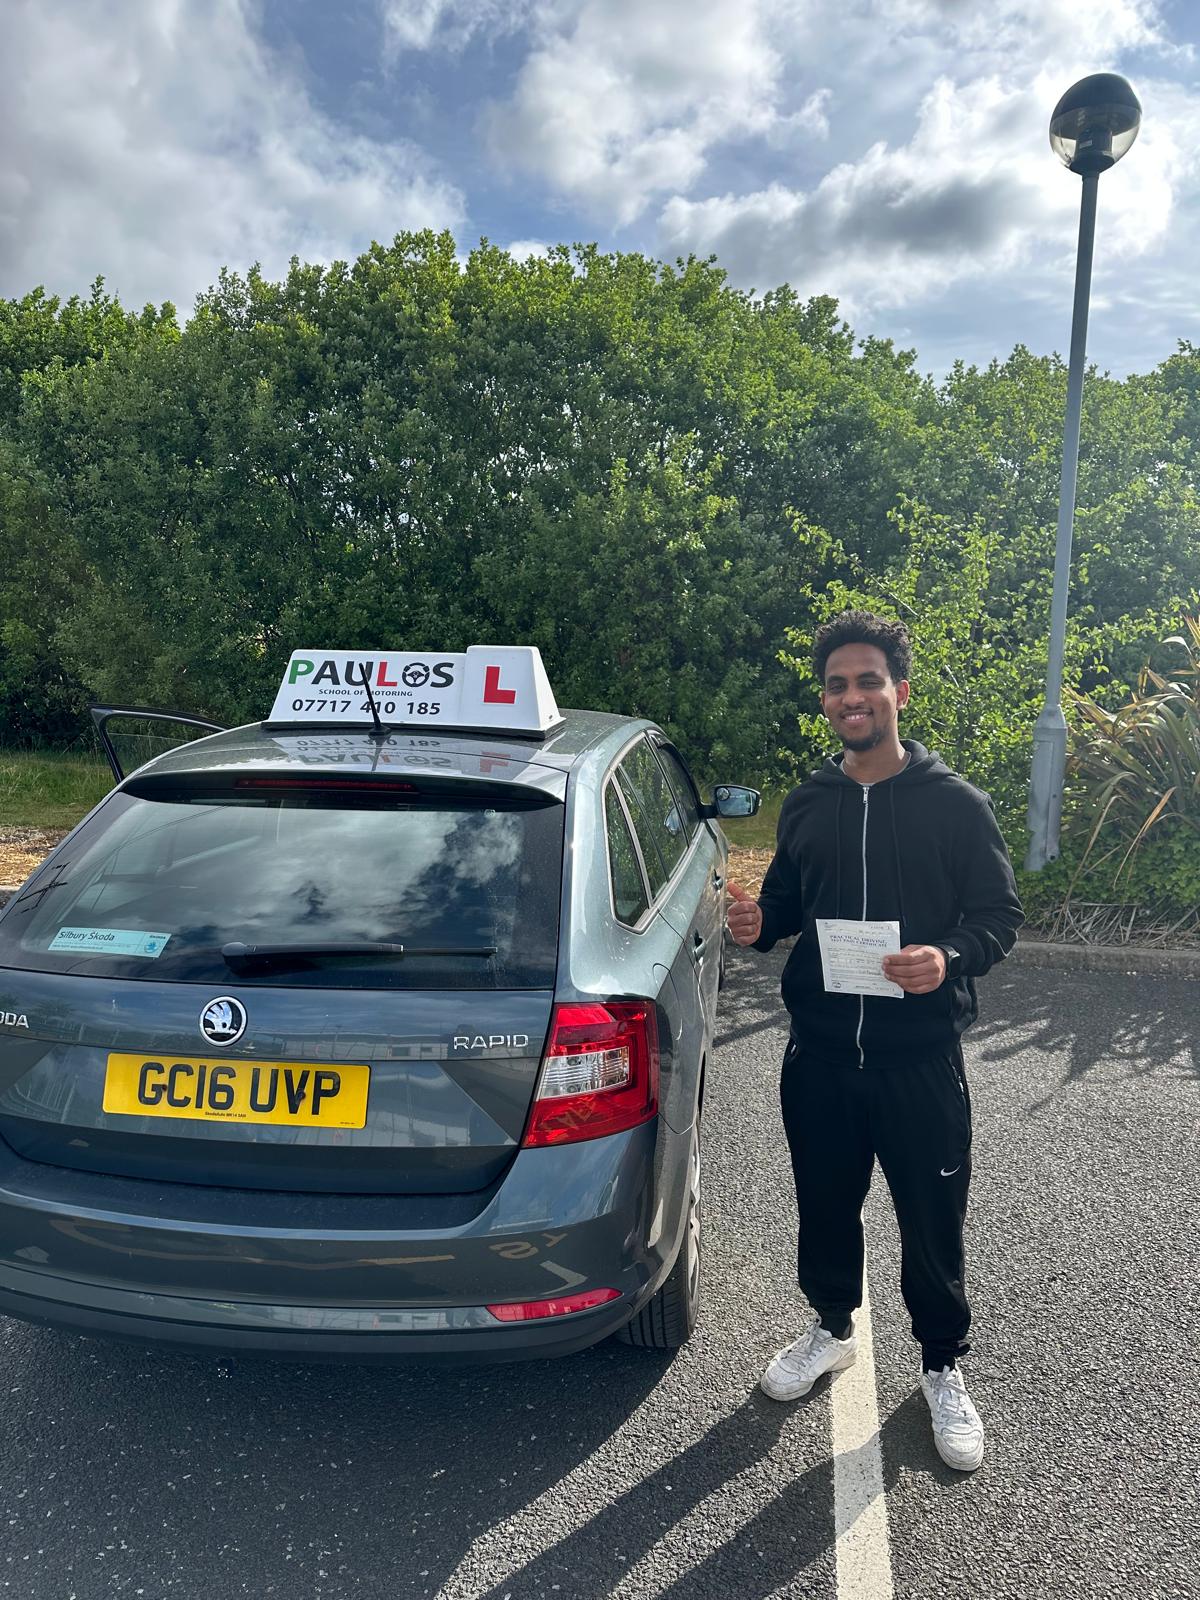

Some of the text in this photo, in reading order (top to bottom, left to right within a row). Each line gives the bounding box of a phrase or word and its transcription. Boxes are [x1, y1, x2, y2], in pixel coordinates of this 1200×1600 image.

[287, 659, 455, 688] PAULOS
[318, 688, 352, 696] SCHOOL
[483, 665, 517, 704] L
[292, 698, 441, 715] 07717 410 185
[58, 931, 88, 942] Silbury
[453, 1034, 529, 1050] RAPID
[138, 1061, 341, 1116] GC16 UVP
